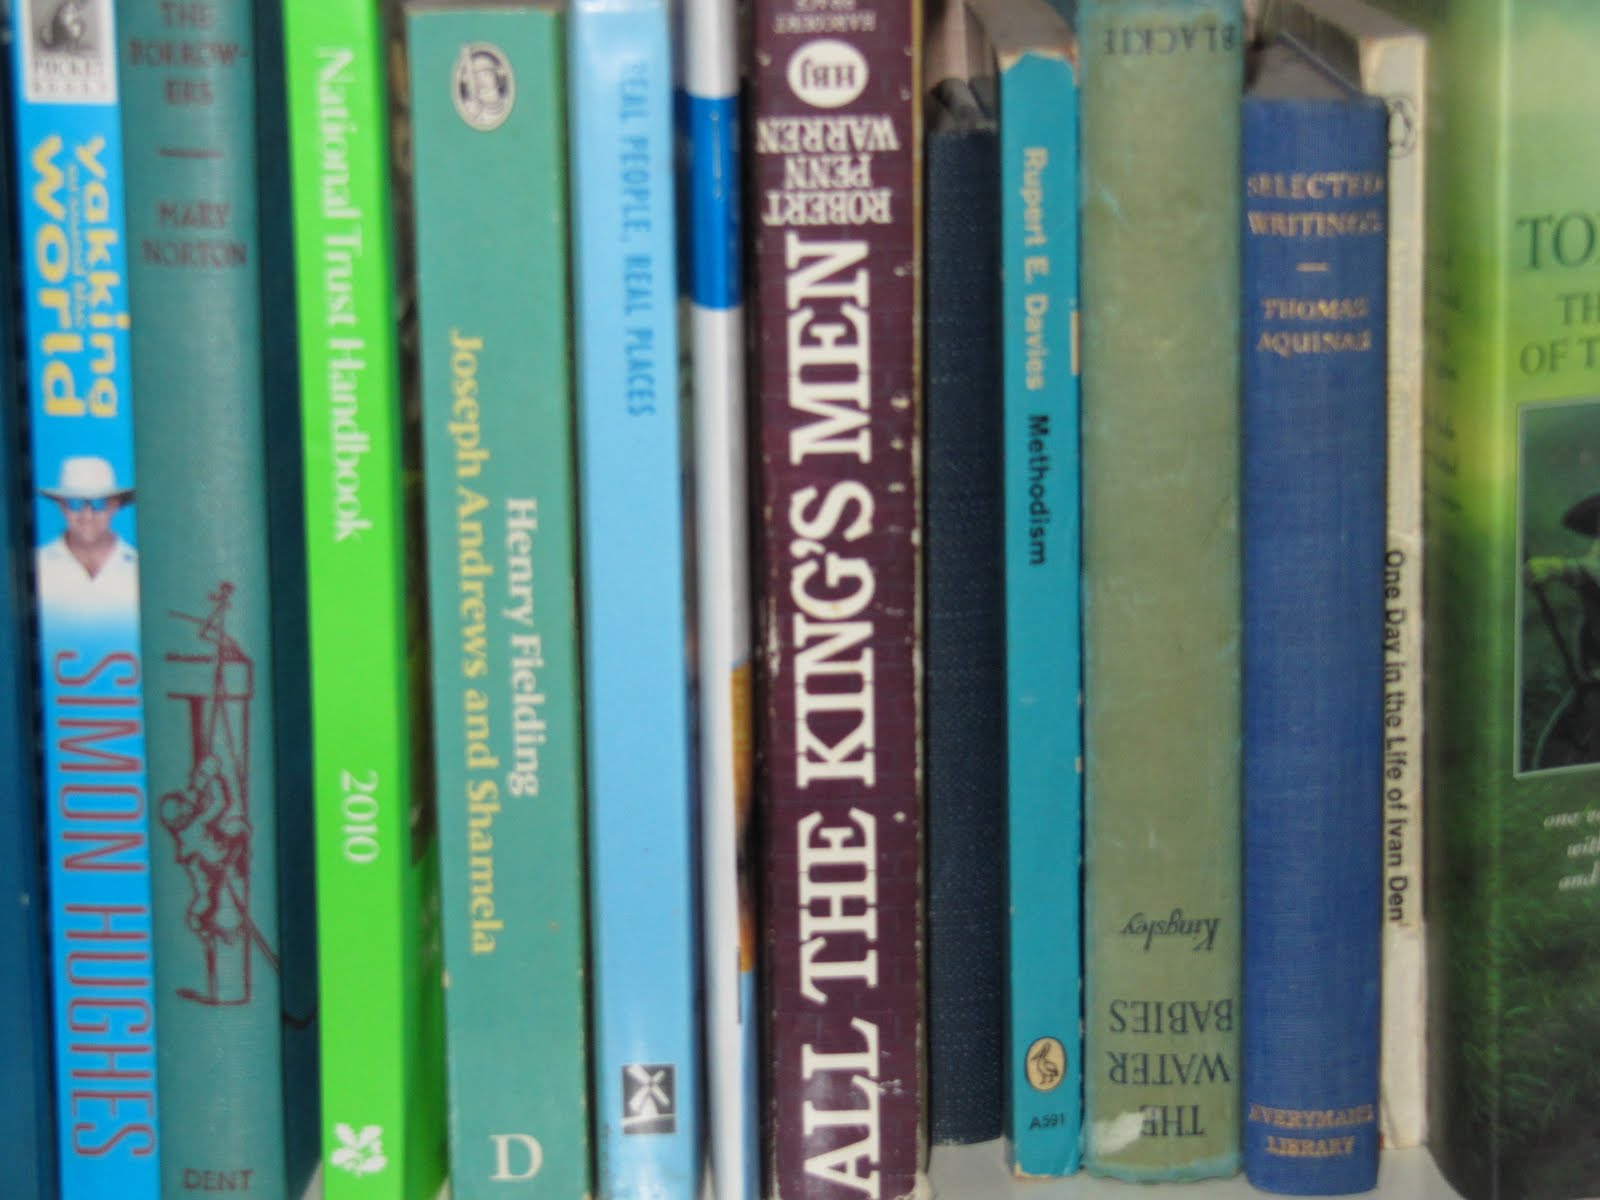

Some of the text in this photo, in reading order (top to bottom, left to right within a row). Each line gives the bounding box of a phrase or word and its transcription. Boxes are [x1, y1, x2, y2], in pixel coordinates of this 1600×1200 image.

[160, 2, 216, 30] THE
[1103, 24, 1236, 57] BLACKIE
[800, 57, 858, 89] HBJ
[756, 115, 900, 154] WARREN
[618, 136, 652, 244] PEOPLE,
[784, 153, 873, 190] PENN
[1247, 172, 1384, 200] SELECTED
[158, 201, 229, 229] MARY
[761, 187, 894, 227] ROBERT
[1247, 209, 1384, 238] WRITINGS
[141, 239, 248, 267] NORTON
[1515, 211, 1600, 271] TO
[32, 135, 84, 419] world
[75, 135, 122, 419] yakking
[622, 253, 654, 317] REAL
[1020, 146, 1050, 391] Rupert E. Davies
[315, 47, 373, 543] National Trust Handbook
[1261, 297, 1371, 320] THOMAS
[1256, 329, 1373, 359] AQUINAS
[624, 328, 656, 418] PLACES
[1025, 412, 1054, 567] Methodism
[1385, 549, 1406, 599] One
[447, 326, 505, 955] Joseph Andrews and Shamela
[502, 498, 548, 799] Henry Fielding
[1381, 608, 1407, 653] Day
[1385, 661, 1407, 684] in
[785, 231, 881, 1200] ALL THE KING'S MEN
[1385, 691, 1408, 728] the
[1386, 736, 1408, 788] Life
[339, 768, 381, 865] 2010
[1387, 789, 1408, 811] of
[1387, 818, 1409, 869] Ivan
[53, 650, 157, 1158] SIMON HUGHES
[1120, 906, 1222, 952] Kingsley
[1109, 999, 1234, 1035] BABIES
[1108, 1050, 1232, 1086] WATER
[1140, 1104, 1206, 1138] THE
[488, 1132, 544, 1183] D
[1266, 1135, 1356, 1158] LIBRARY
[182, 1168, 256, 1192] DENT
